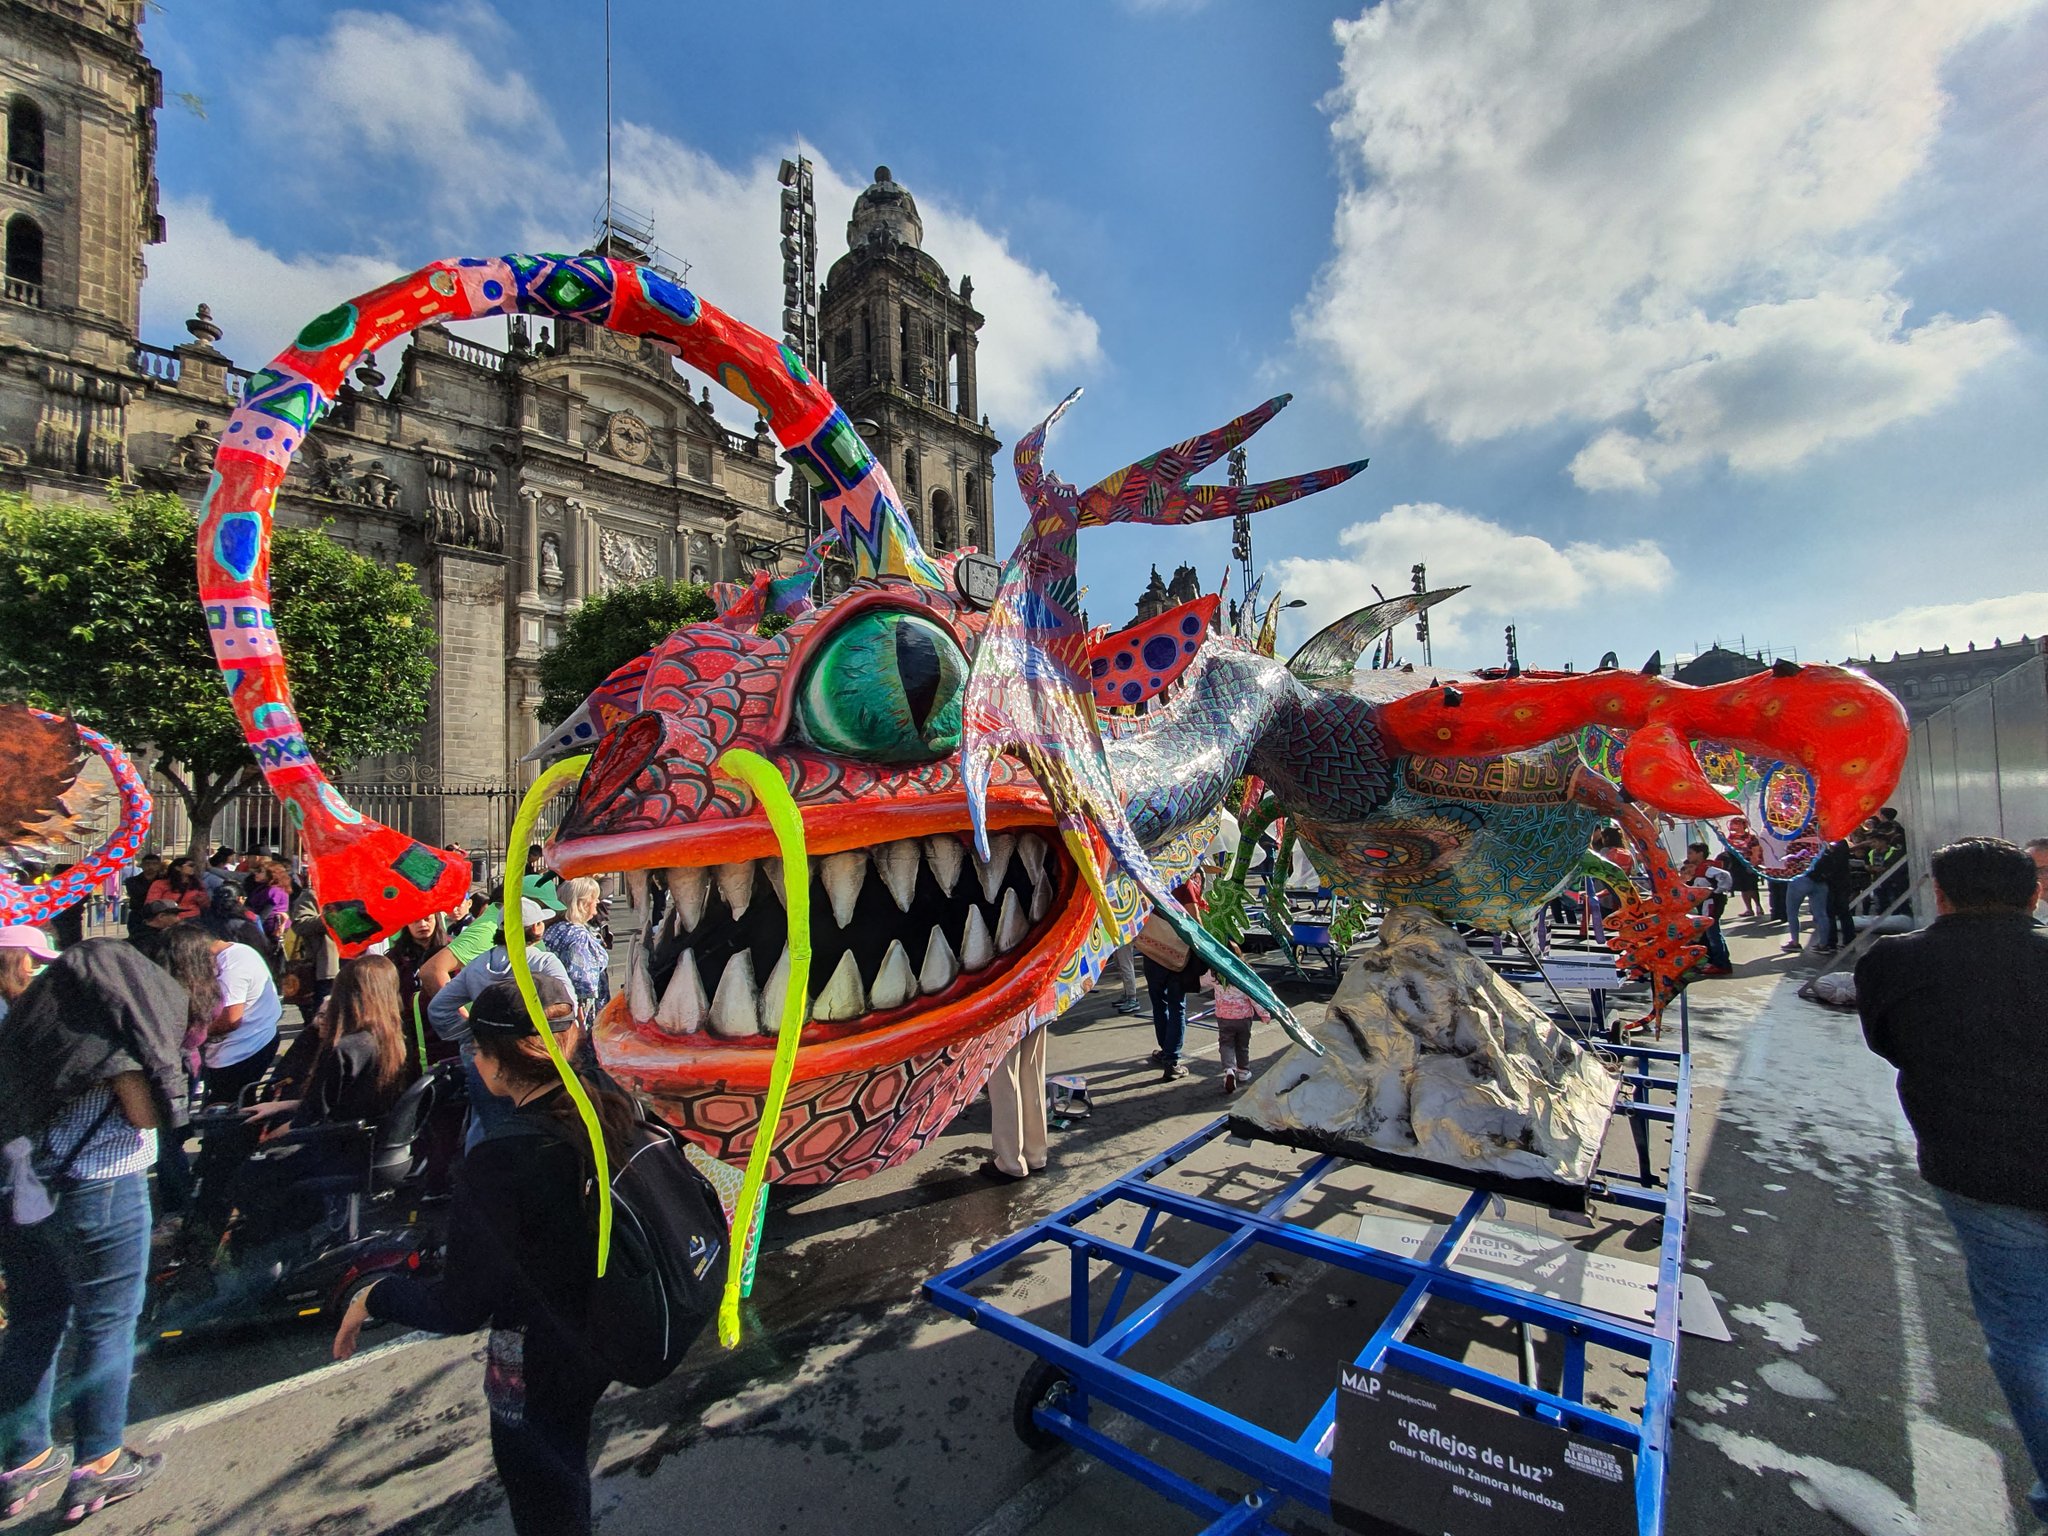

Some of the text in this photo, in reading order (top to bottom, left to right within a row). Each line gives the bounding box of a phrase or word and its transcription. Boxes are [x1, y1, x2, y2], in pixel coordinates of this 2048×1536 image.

[1341, 1369, 1381, 1395] MAP
[1397, 1418, 1477, 1460] “Reflejos
[1481, 1447, 1504, 1469] de
[1509, 1455, 1553, 1482] Luz”
[1564, 1448, 1623, 1475] ALEBRIJES
[1389, 1440, 1565, 1512] Omar Tonatiuh Zamora Mendoza
[1452, 1485, 1493, 1507] RPV-SUR
